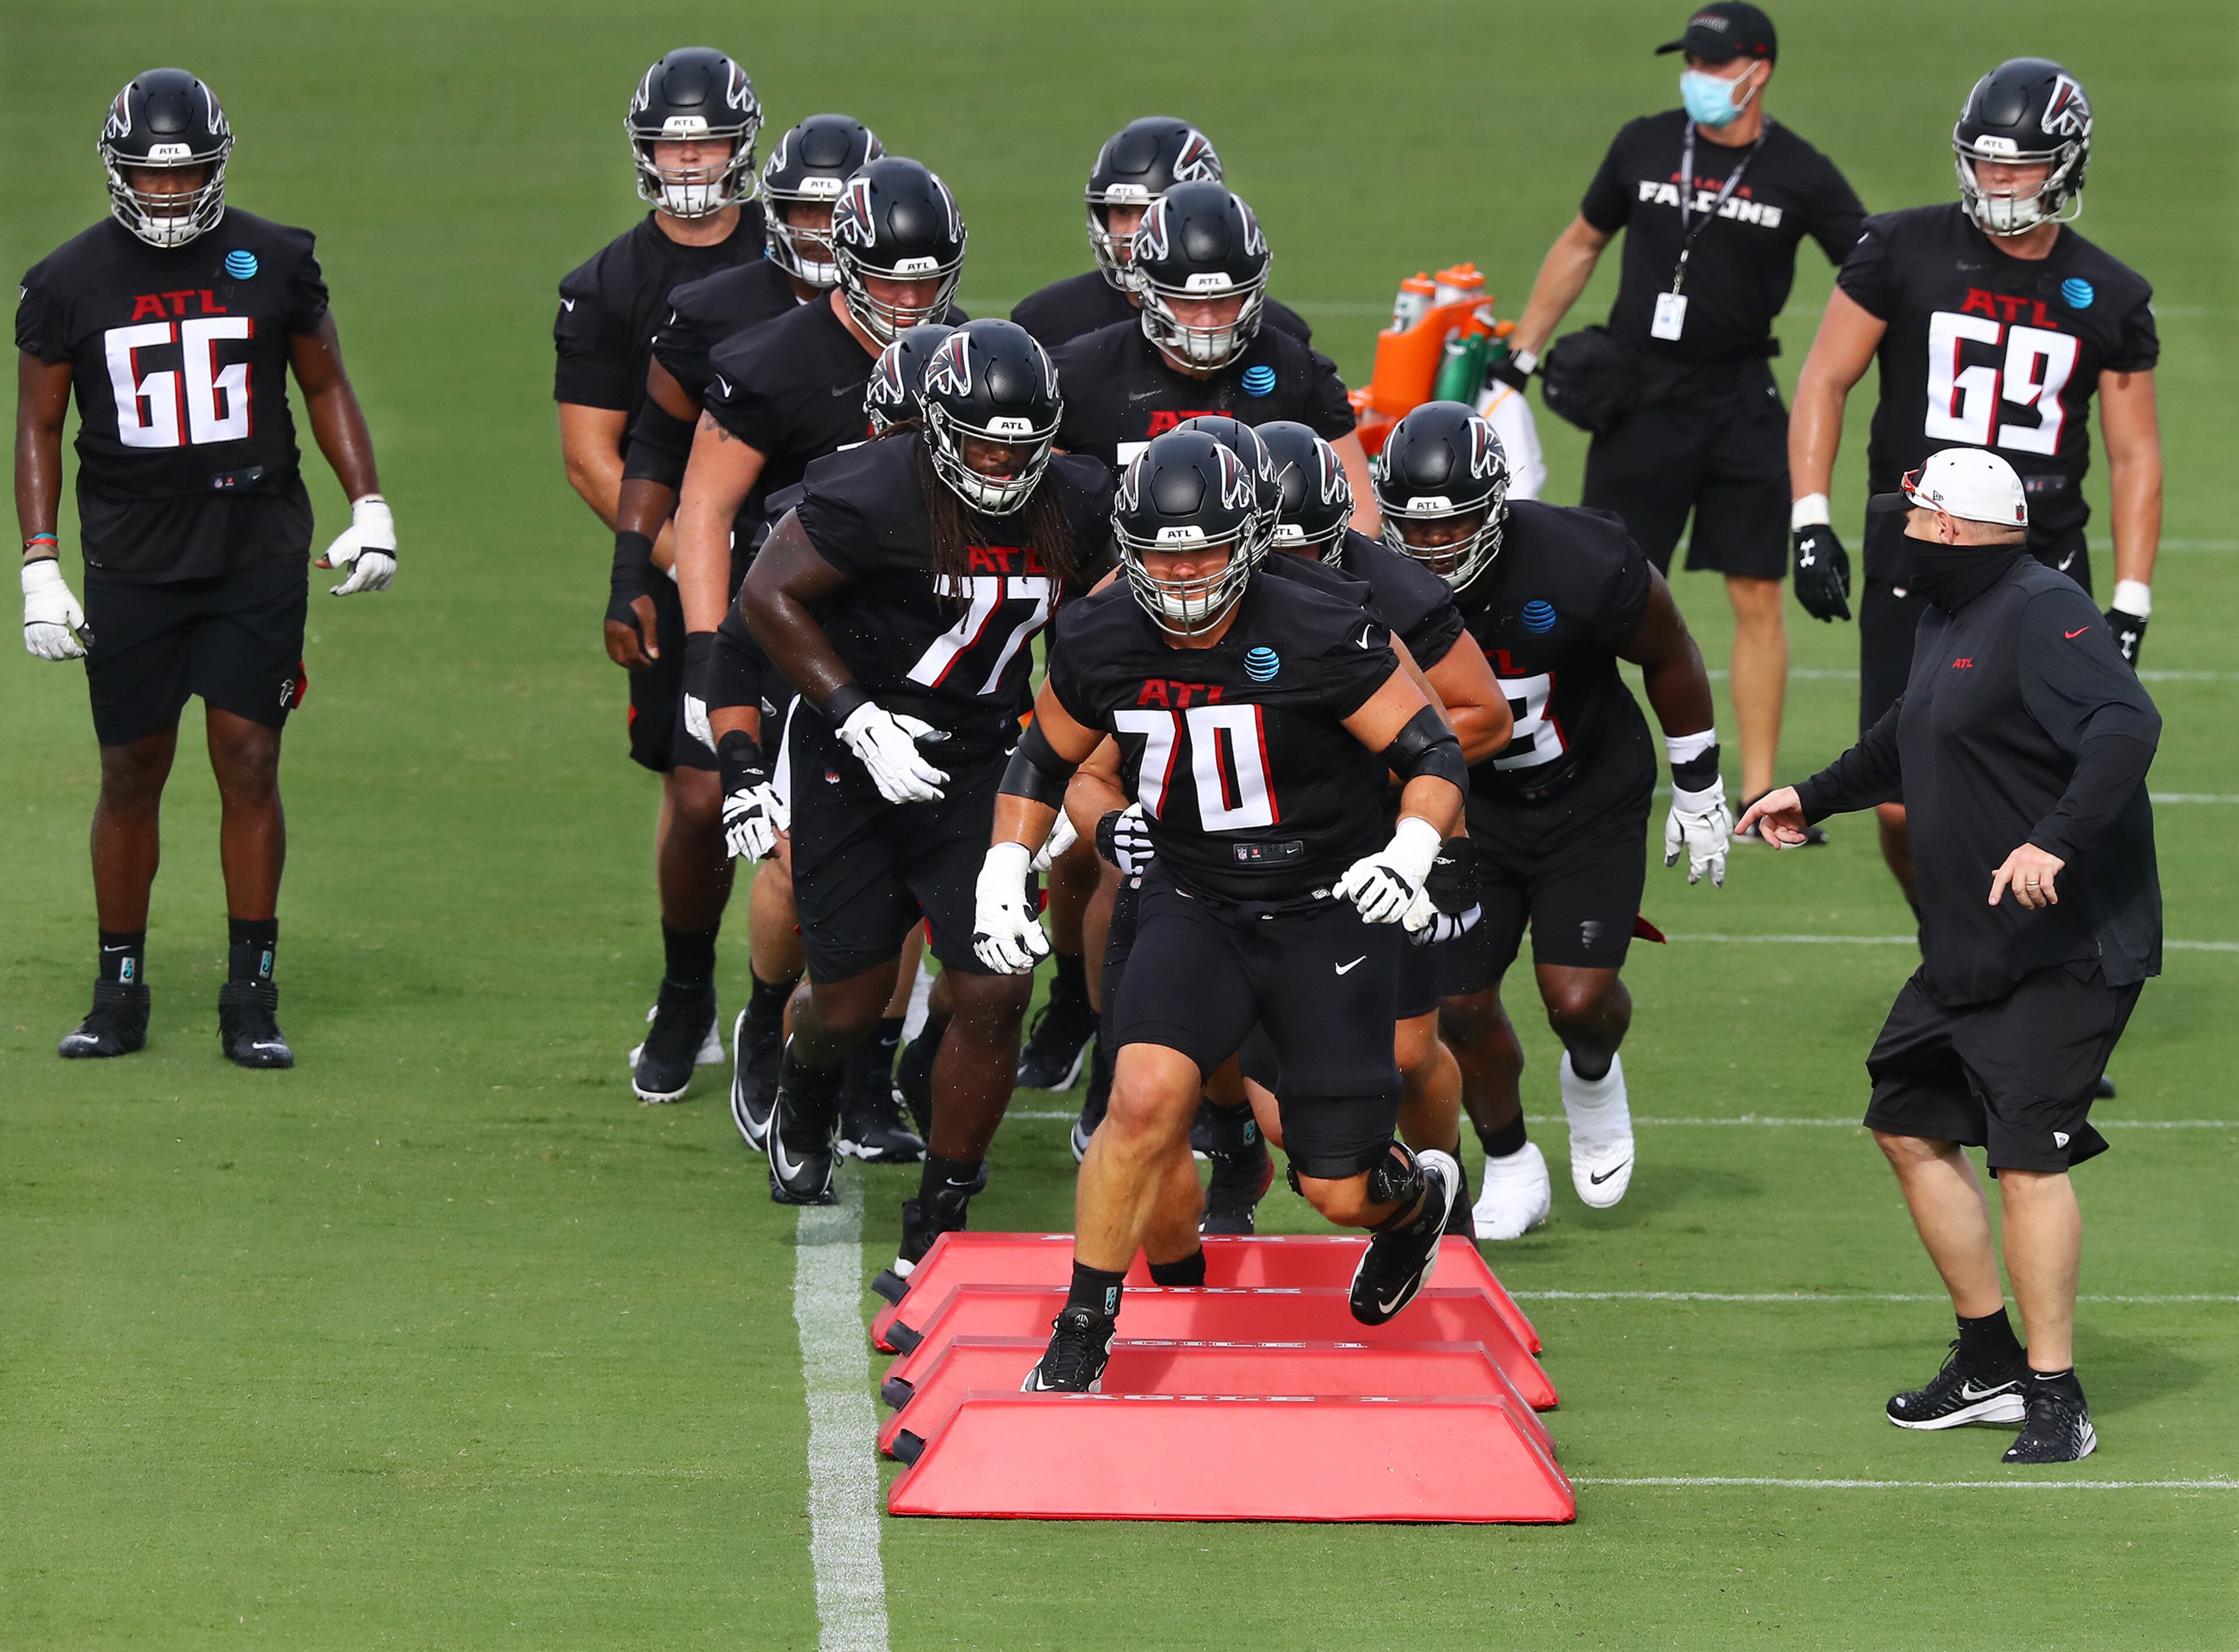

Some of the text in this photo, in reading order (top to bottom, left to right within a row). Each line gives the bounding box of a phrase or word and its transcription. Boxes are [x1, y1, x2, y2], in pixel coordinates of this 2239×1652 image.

[1983, 139, 2003, 149] ATL
[1114, 187, 1135, 196] ATL
[1638, 180, 1784, 229] FACONS
[907, 262, 929, 271] ATL
[1198, 277, 1222, 286] ATL
[132, 290, 227, 321] ATL
[1960, 288, 2058, 328] ATL
[104, 317, 254, 448] 66
[1924, 311, 2082, 456] 69
[1001, 421, 1024, 430] ATL
[1416, 502, 1439, 510] ATL
[1167, 530, 1191, 539] ATL
[966, 546, 1047, 573] ATL
[906, 574, 1064, 695] 77
[1952, 658, 1973, 669] ATL
[1138, 679, 1234, 708] ATL
[1492, 672, 1568, 771] 3
[1113, 704, 1280, 832] 70
